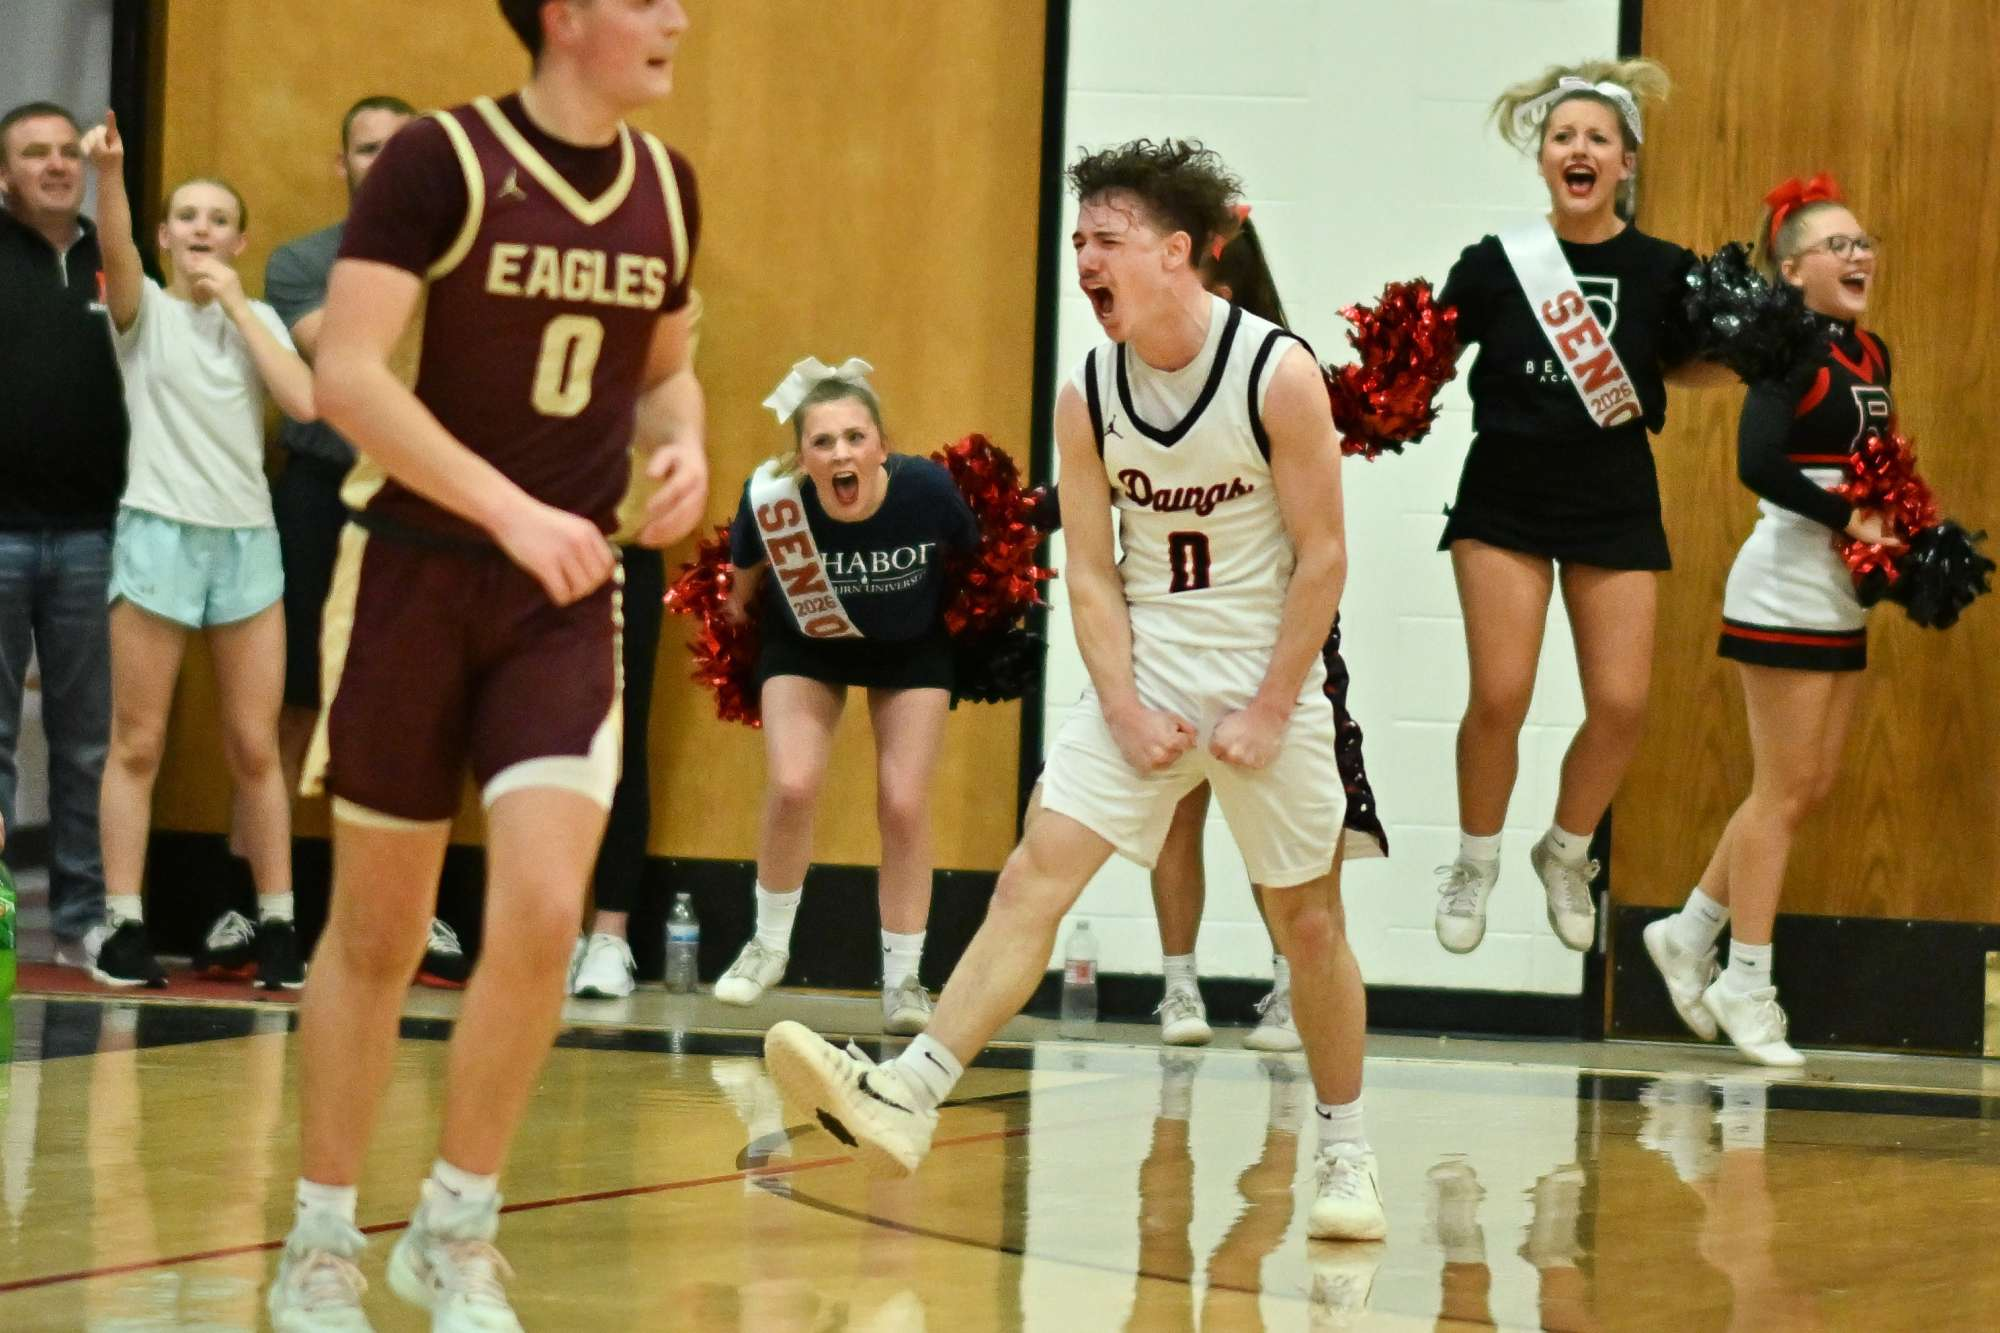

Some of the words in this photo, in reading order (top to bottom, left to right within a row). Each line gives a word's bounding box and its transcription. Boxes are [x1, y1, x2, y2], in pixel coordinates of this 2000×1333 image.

[485, 241, 668, 311] EAGLES
[531, 313, 605, 418] 0
[1590, 382, 1634, 416] 2026
[1117, 468, 1255, 517] Dawgs
[1167, 530, 1211, 594] 0
[793, 595, 838, 618] 2026
